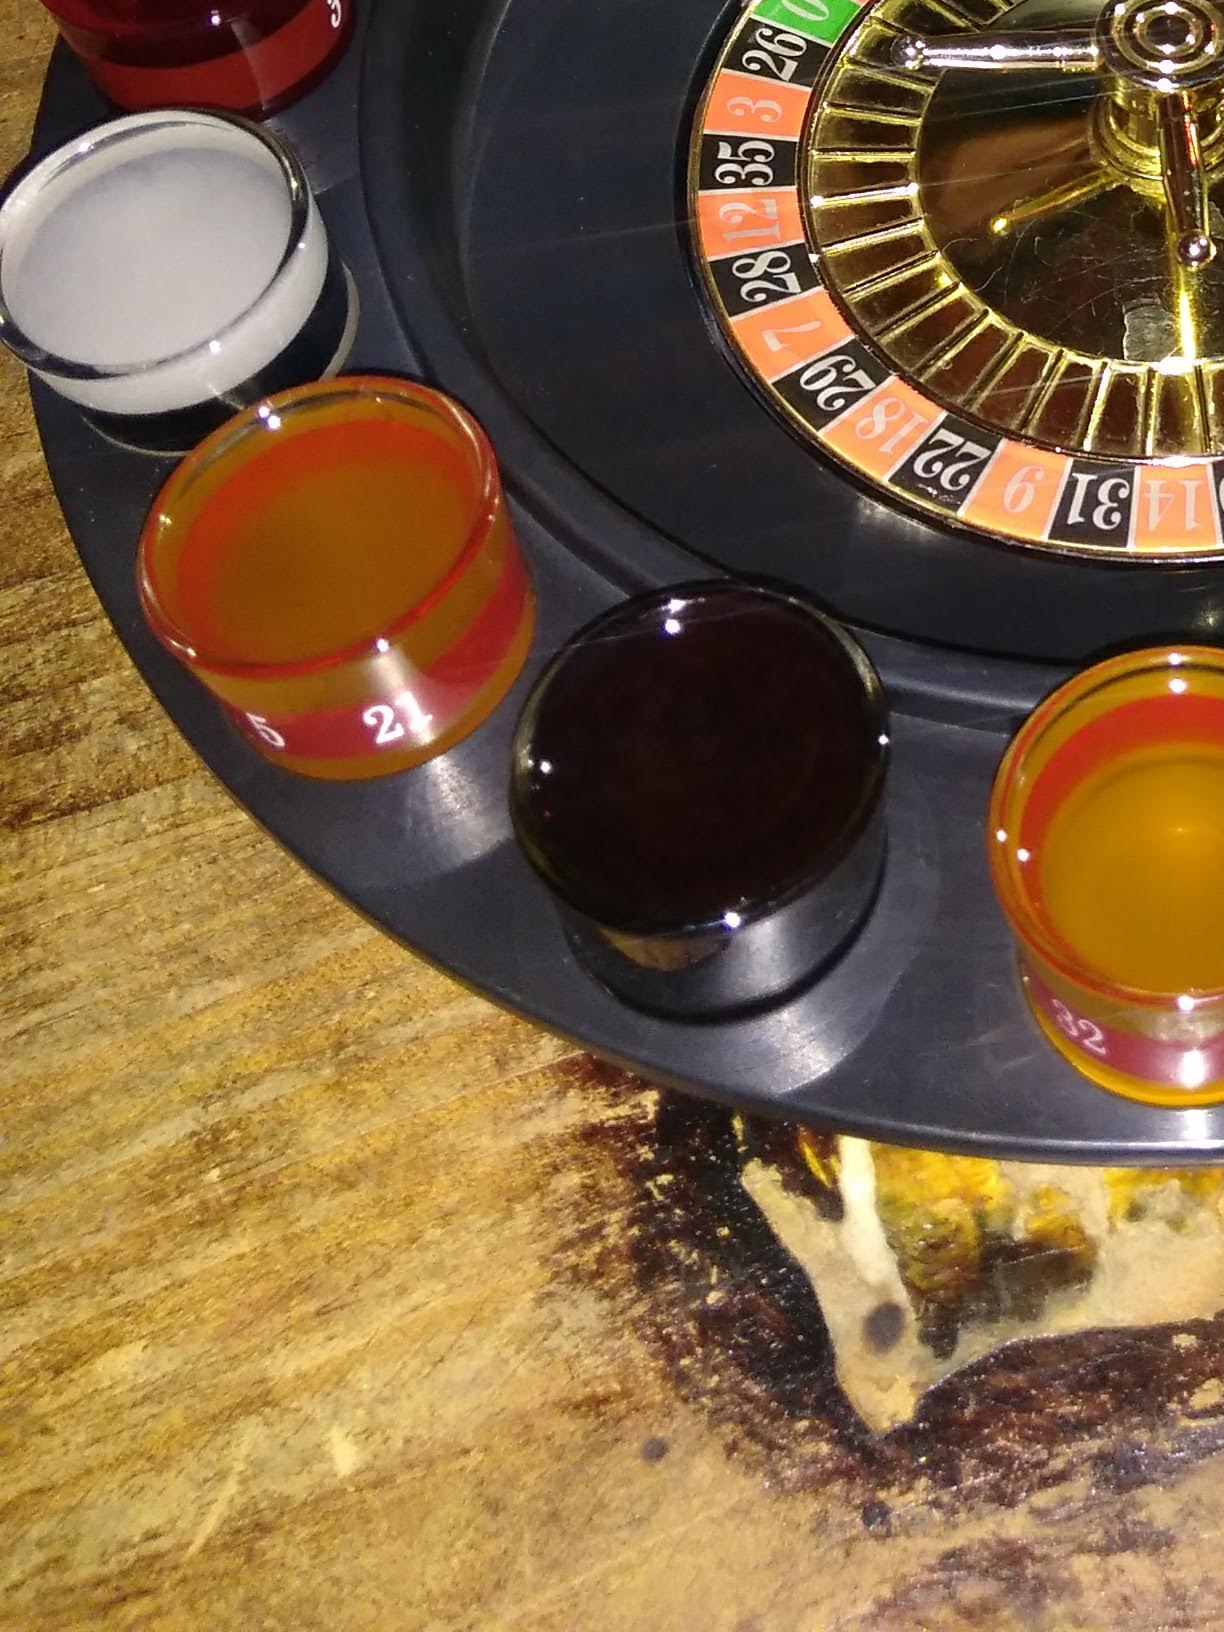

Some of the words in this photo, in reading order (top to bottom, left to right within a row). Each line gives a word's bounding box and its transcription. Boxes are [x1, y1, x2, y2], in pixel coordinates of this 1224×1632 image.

[742, 27, 808, 83] 26
[726, 96, 783, 123] 3
[714, 140, 775, 186] 35
[719, 199, 780, 243] 12
[732, 250, 801, 303] 28
[761, 320, 822, 353] 7
[800, 354, 876, 411] 29
[855, 396, 929, 455] 18
[912, 429, 991, 492] 22
[1066, 472, 1130, 530] 31
[1143, 479, 1204, 531] 14
[1052, 998, 1106, 1056] 32
